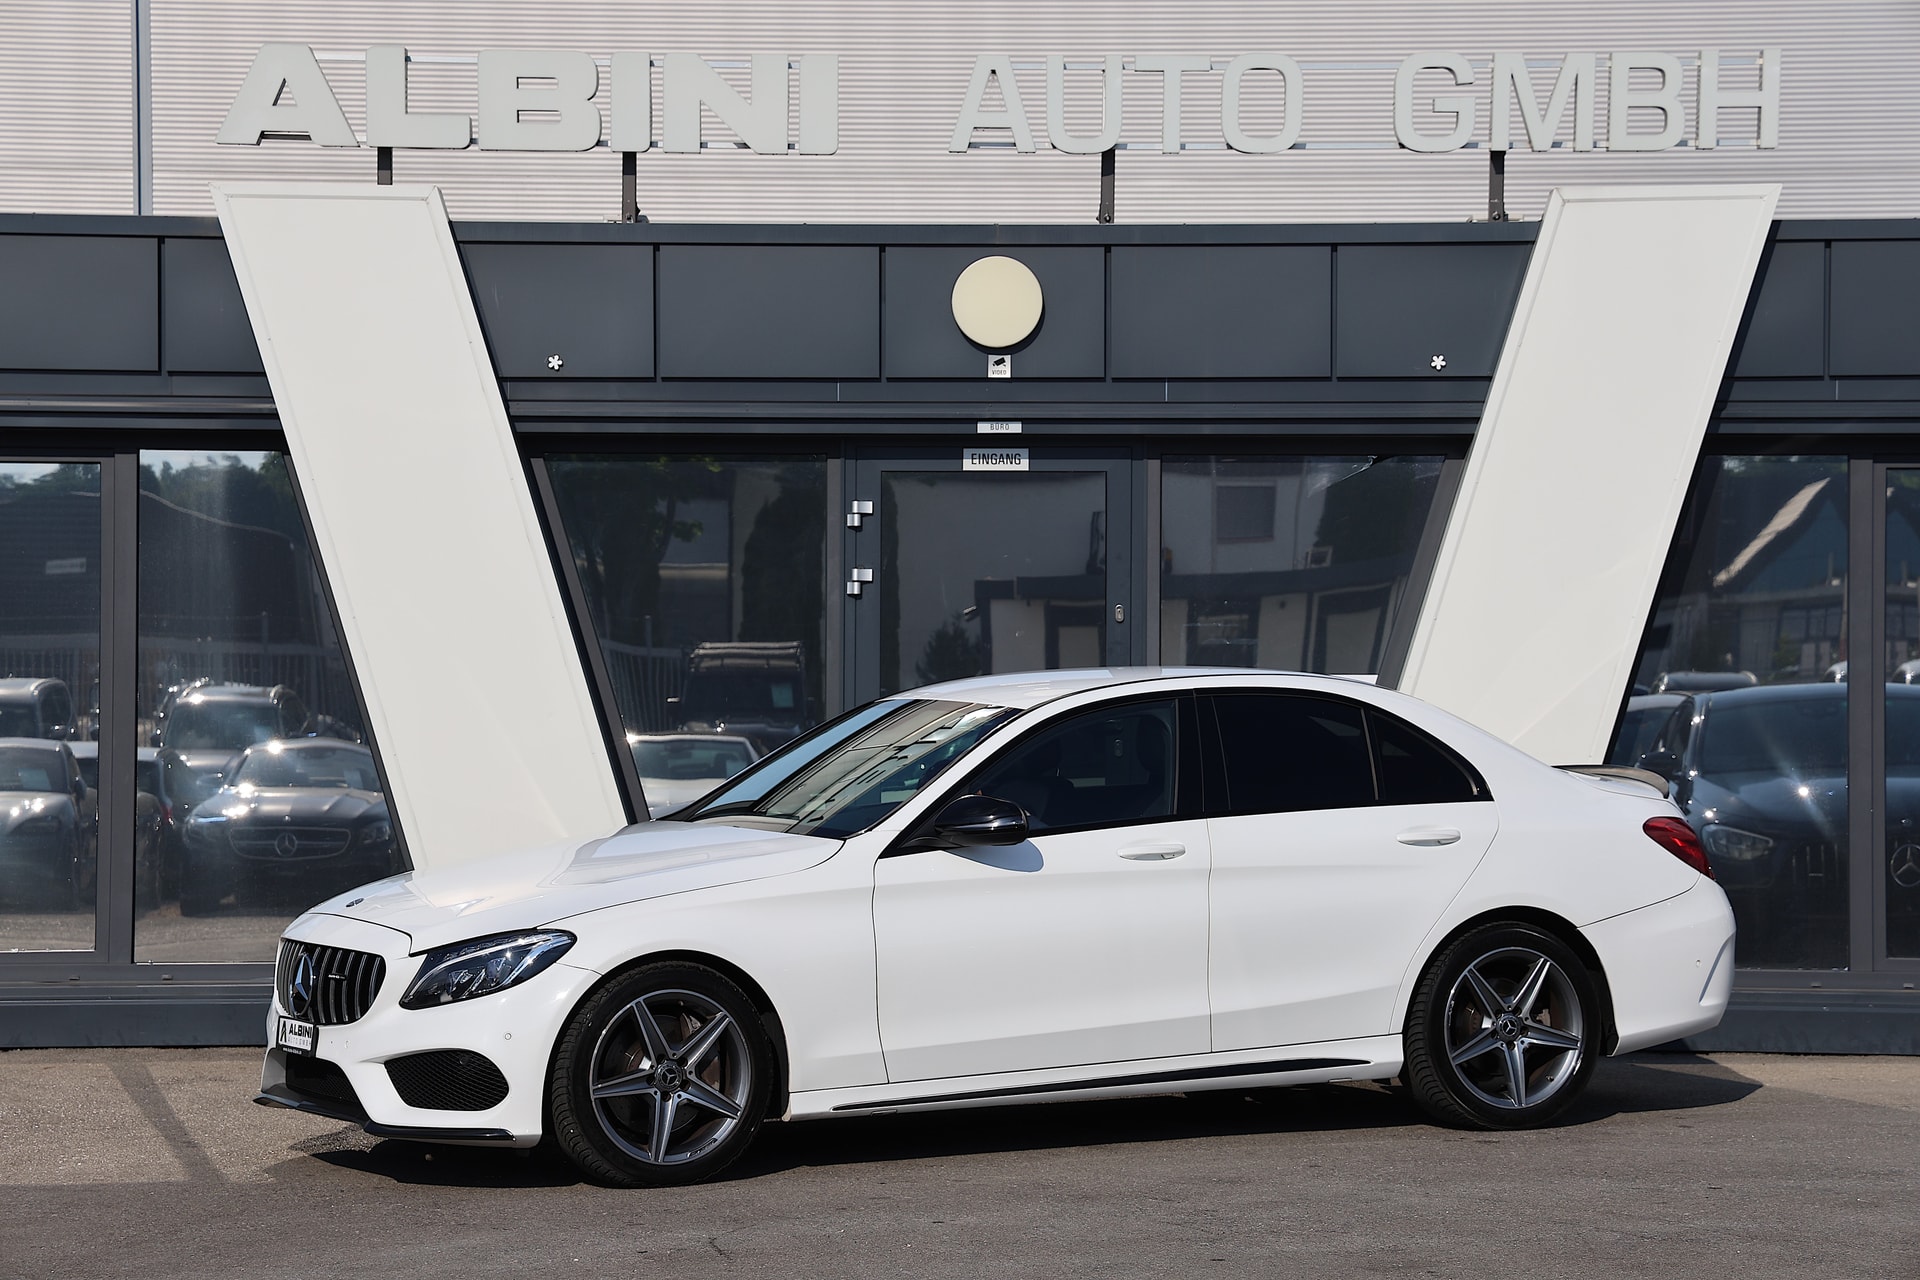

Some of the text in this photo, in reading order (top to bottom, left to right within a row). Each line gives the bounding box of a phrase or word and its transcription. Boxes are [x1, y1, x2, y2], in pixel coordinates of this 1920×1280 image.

[215, 43, 1782, 155] ALBINI AUTO GMBH
[971, 453, 1022, 465] EINGANG
[289, 1023, 312, 1039] ALBINI
